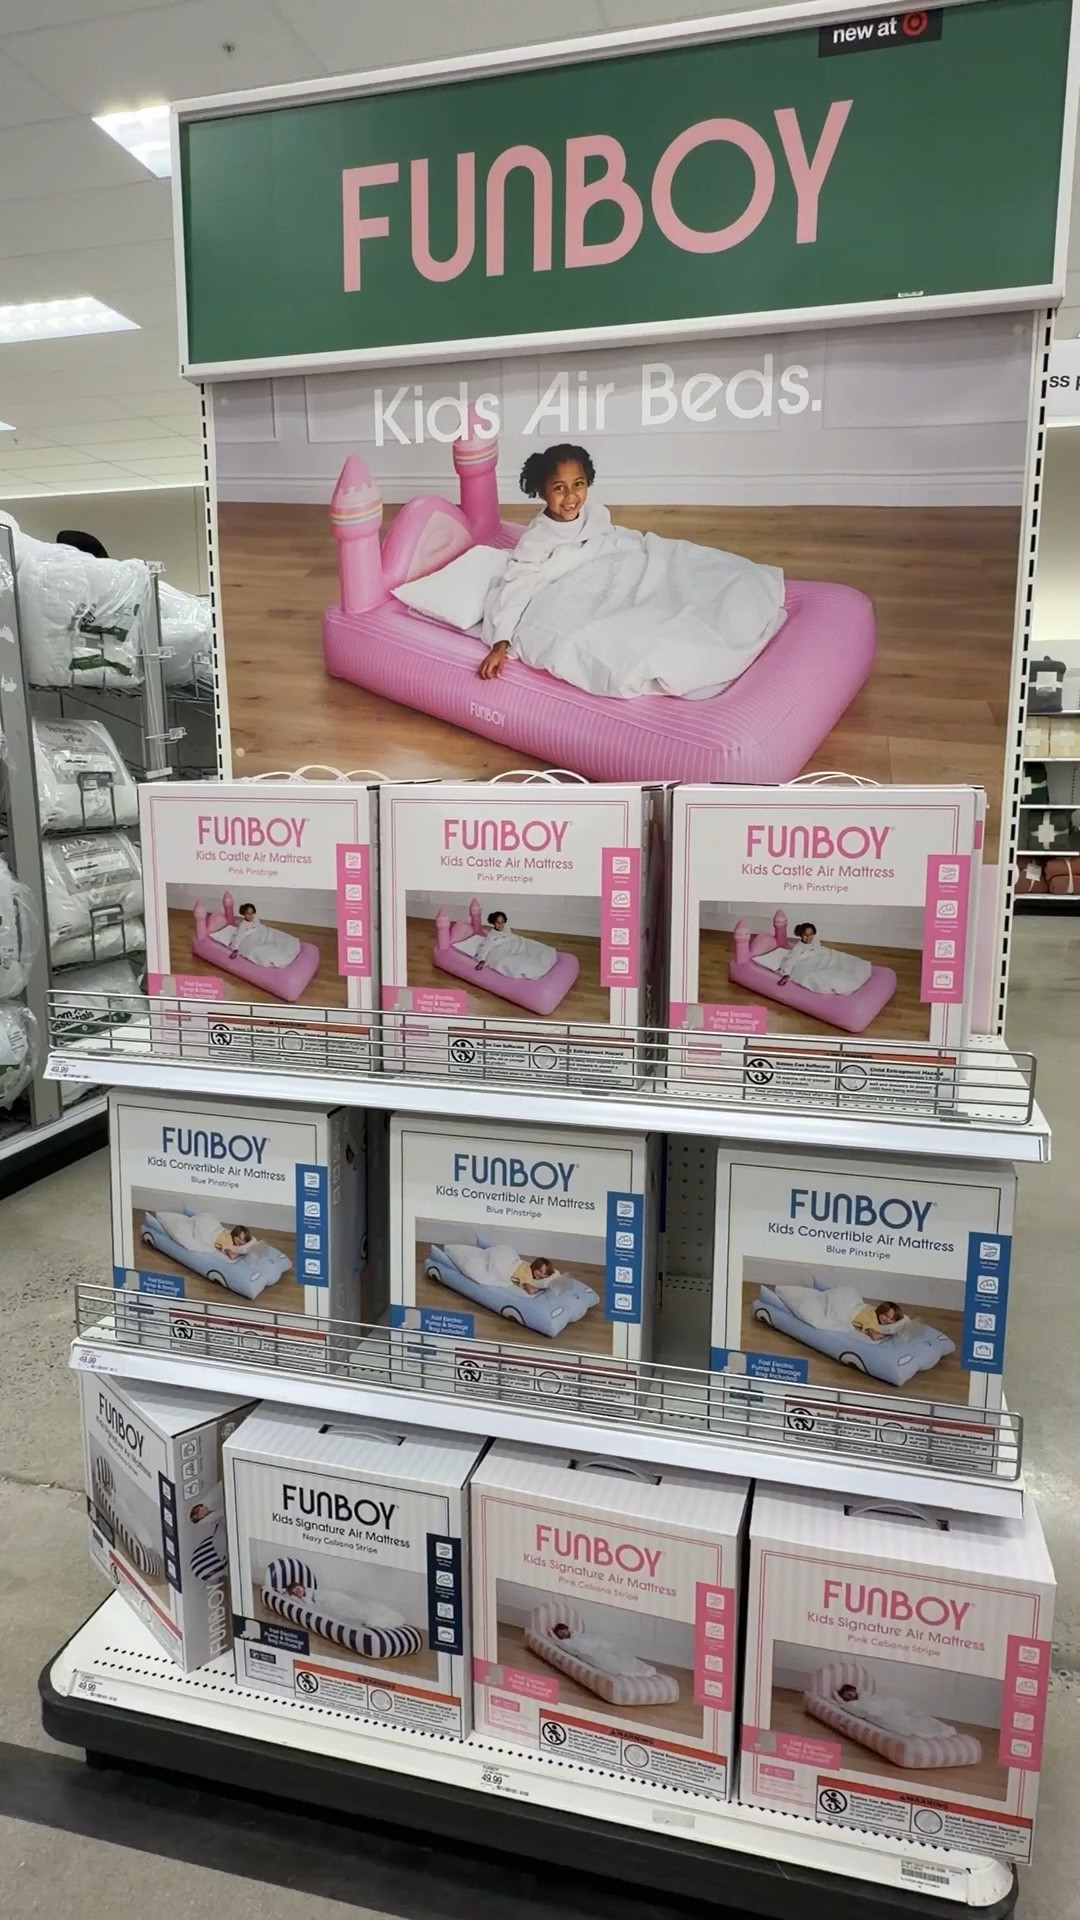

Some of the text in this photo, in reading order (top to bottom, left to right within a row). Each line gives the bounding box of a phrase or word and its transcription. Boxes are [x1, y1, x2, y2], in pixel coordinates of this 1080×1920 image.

[833, 17, 897, 43] new at
[342, 99, 854, 293] FUNBOY
[374, 354, 822, 446] Kids Air Beds.
[470, 702, 505, 727] FUNBOY
[198, 816, 306, 848] FUNBOY
[444, 819, 570, 852] FUNBOY
[747, 825, 890, 859] FUNBOY
[196, 851, 312, 864] Kids Castle Air Mattress
[228, 866, 243, 875] Pink
[440, 856, 573, 870] Kids Castle Air Mattress
[742, 864, 894, 878] Kids Castle Air Mattress
[477, 874, 533, 883] Pink Pinstripe
[784, 883, 848, 893] Pink Pinstripe
[162, 1126, 267, 1164] FUNBOY
[148, 1156, 285, 1182] Kids Convertible Air Mattress
[191, 1176, 239, 1189] Blue Pinstripe
[454, 1154, 575, 1192] FUNBOY
[436, 1185, 595, 1210] Kids Convertible Air Mattress
[790, 1189, 933, 1232] FUNBOY
[486, 1206, 542, 1218] Blue Pinstripe
[768, 1222, 954, 1252] Kids Convertible Air Mattress
[826, 1245, 891, 1260] Blue Pinstripe
[99, 1392, 144, 1457] FUNBOY
[283, 1484, 395, 1530] FUNBOY
[272, 1513, 410, 1548] Kids Signature Air Mattress
[302, 1533, 321, 1544] Navy
[356, 1544, 378, 1554] Stripe
[536, 1524, 662, 1577] FUNBOY
[523, 1553, 676, 1597] Kids Signature Air Mattress
[558, 1576, 576, 1587] Pink
[614, 1587, 639, 1601] Stripe
[206, 1582, 227, 1655] FUNBOY
[823, 1579, 971, 1630] FUNBOY
[807, 1612, 985, 1651] Kids Signature Air Mattress
[848, 1634, 869, 1645] Pink
[912, 1645, 940, 1657] Stripe
[482, 1774, 502, 1785] 49.99
